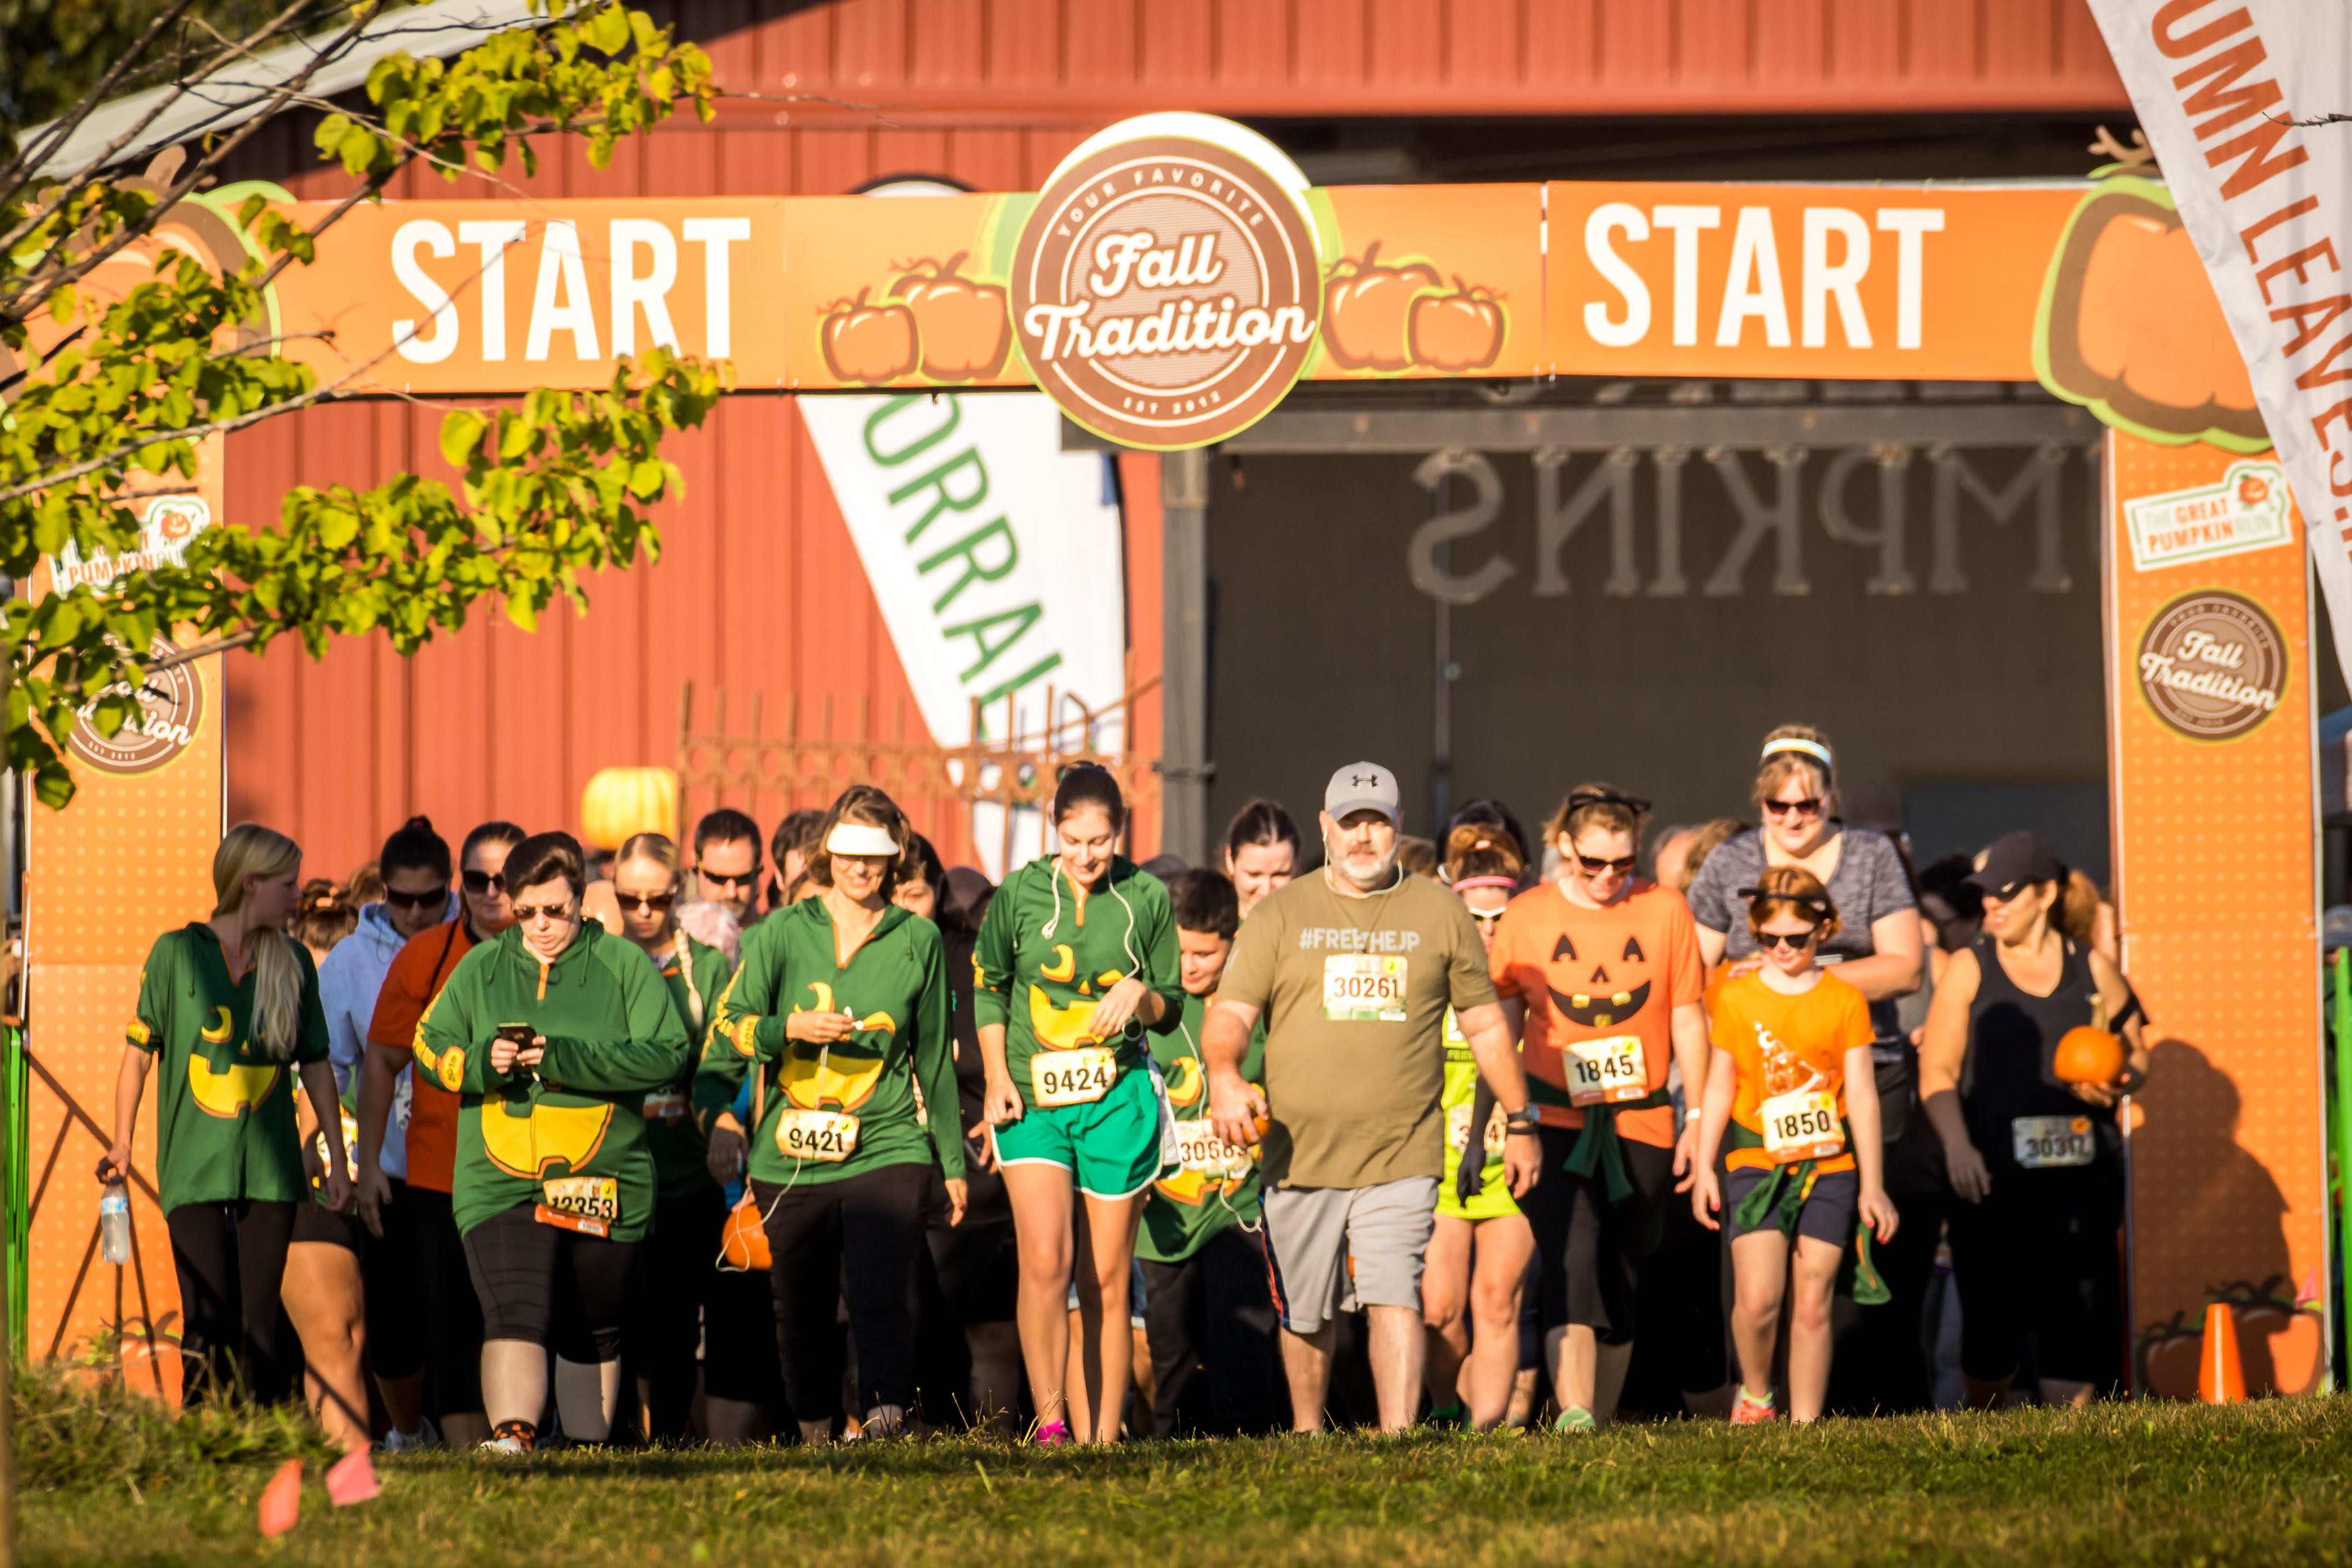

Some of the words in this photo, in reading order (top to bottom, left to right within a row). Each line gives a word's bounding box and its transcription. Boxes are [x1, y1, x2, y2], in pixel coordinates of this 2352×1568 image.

[1057, 182, 1117, 238] YOUR
[1134, 168, 1264, 227] FAVORITE
[1090, 232, 1224, 298] Fall
[1583, 202, 1945, 350] START
[391, 216, 751, 364] START
[1023, 296, 1316, 361] Tradition
[1123, 396, 1159, 415] EST
[1172, 390, 1221, 415] 2012
[2175, 497, 2228, 524] GREAT
[2147, 519, 2234, 553] PUMPKIN
[69, 552, 155, 585] PUMPKIN
[2177, 630, 2245, 669] Fall
[2139, 651, 2280, 712] Tradition
[1333, 977, 1399, 1000] 30261
[1044, 1066, 1108, 1095] 9424
[1575, 1054, 1635, 1084] 1845
[789, 1127, 843, 1153] 9421
[1773, 1110, 1831, 1139] 1850
[552, 1196, 614, 1221] 12353
